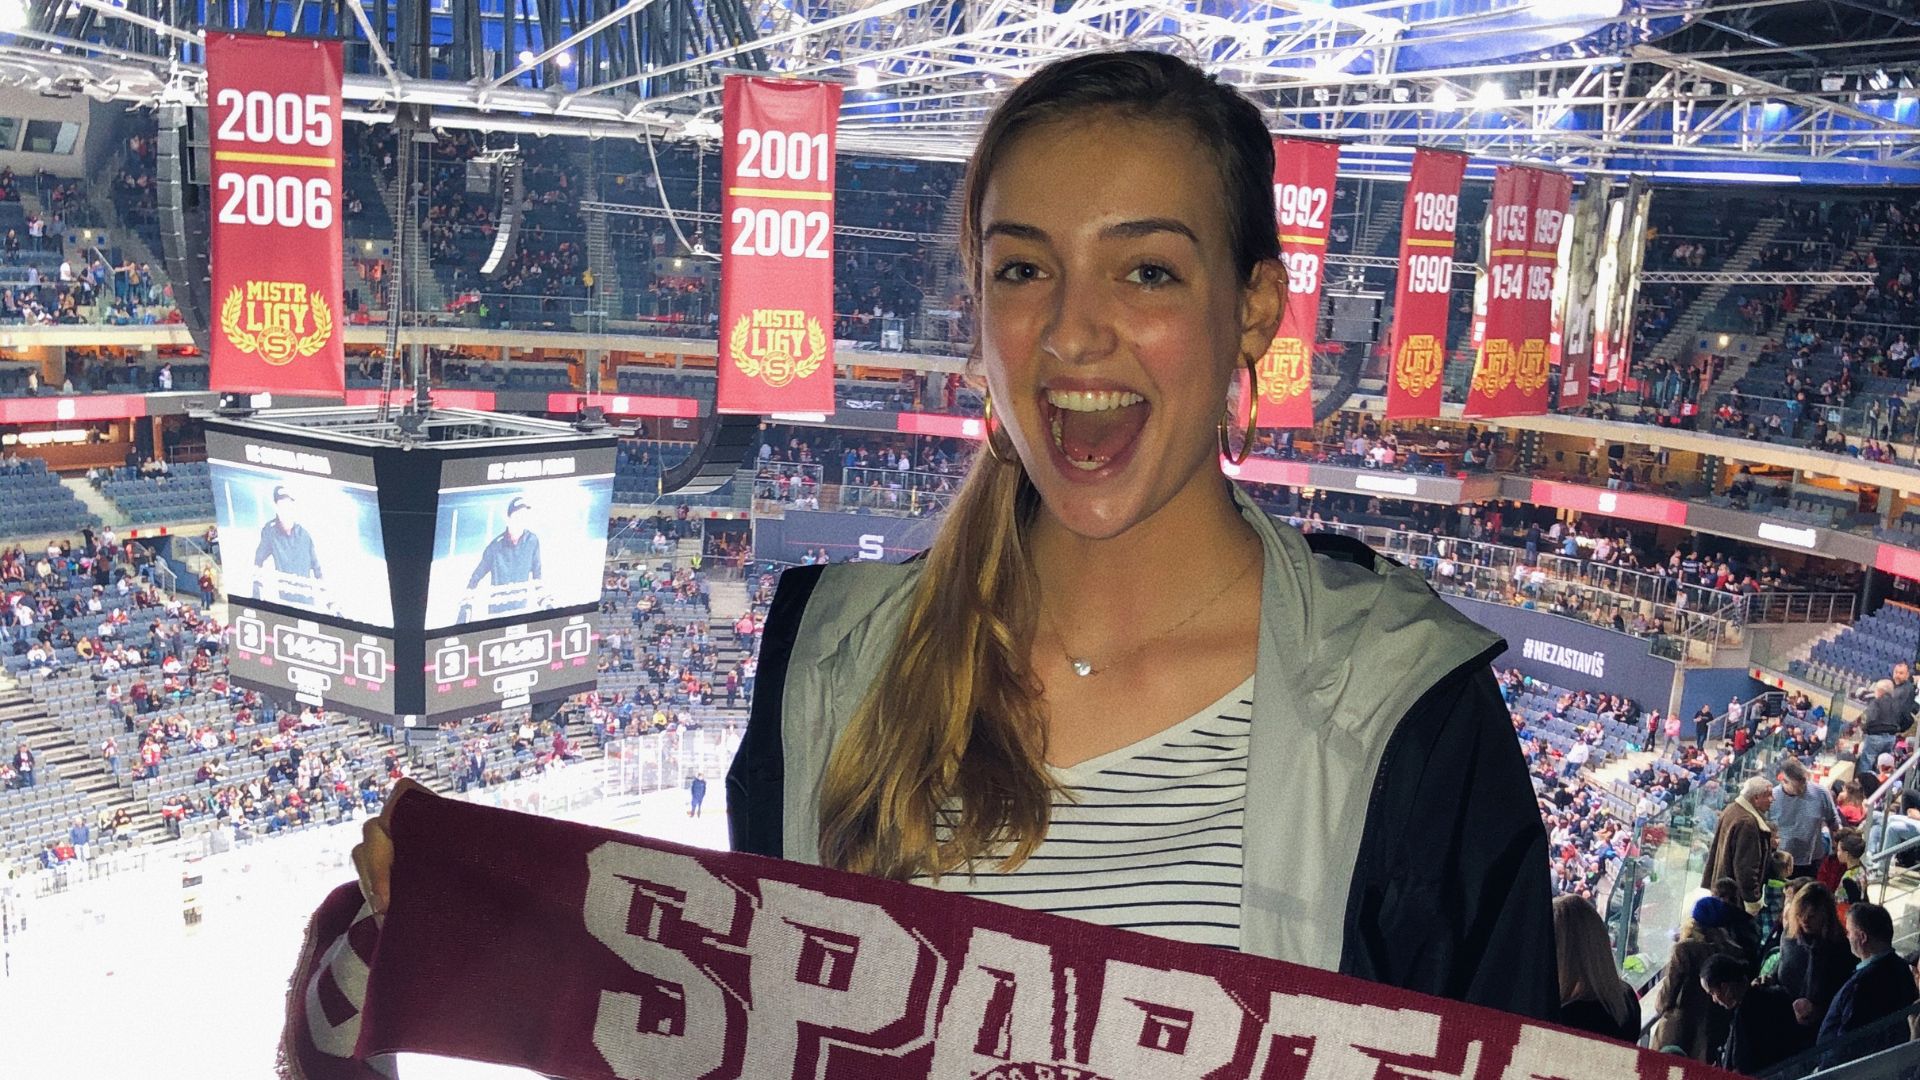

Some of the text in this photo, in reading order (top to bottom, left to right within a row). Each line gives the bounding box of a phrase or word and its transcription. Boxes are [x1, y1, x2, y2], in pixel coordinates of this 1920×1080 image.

[217, 88, 333, 147] 2005
[736, 128, 829, 181] 2001
[218, 172, 333, 229] 2006
[1273, 183, 1328, 229] 1992
[1414, 192, 1458, 232] 1989
[731, 207, 830, 259] 2002
[1496, 205, 1528, 242] 153
[246, 280, 307, 303] MISTR
[1279, 252, 1319, 294] 93
[1408, 255, 1452, 294] 1990
[246, 301, 309, 334] LIGY
[752, 308, 805, 329] MISTR
[751, 328, 806, 357] LIGY
[1262, 353, 1301, 378] LIGY
[1405, 350, 1433, 373] LIGY
[858, 534, 884, 560] S
[569, 629, 582, 652] 1
[362, 651, 376, 675] 1
[583, 839, 1645, 1080] SPAR
